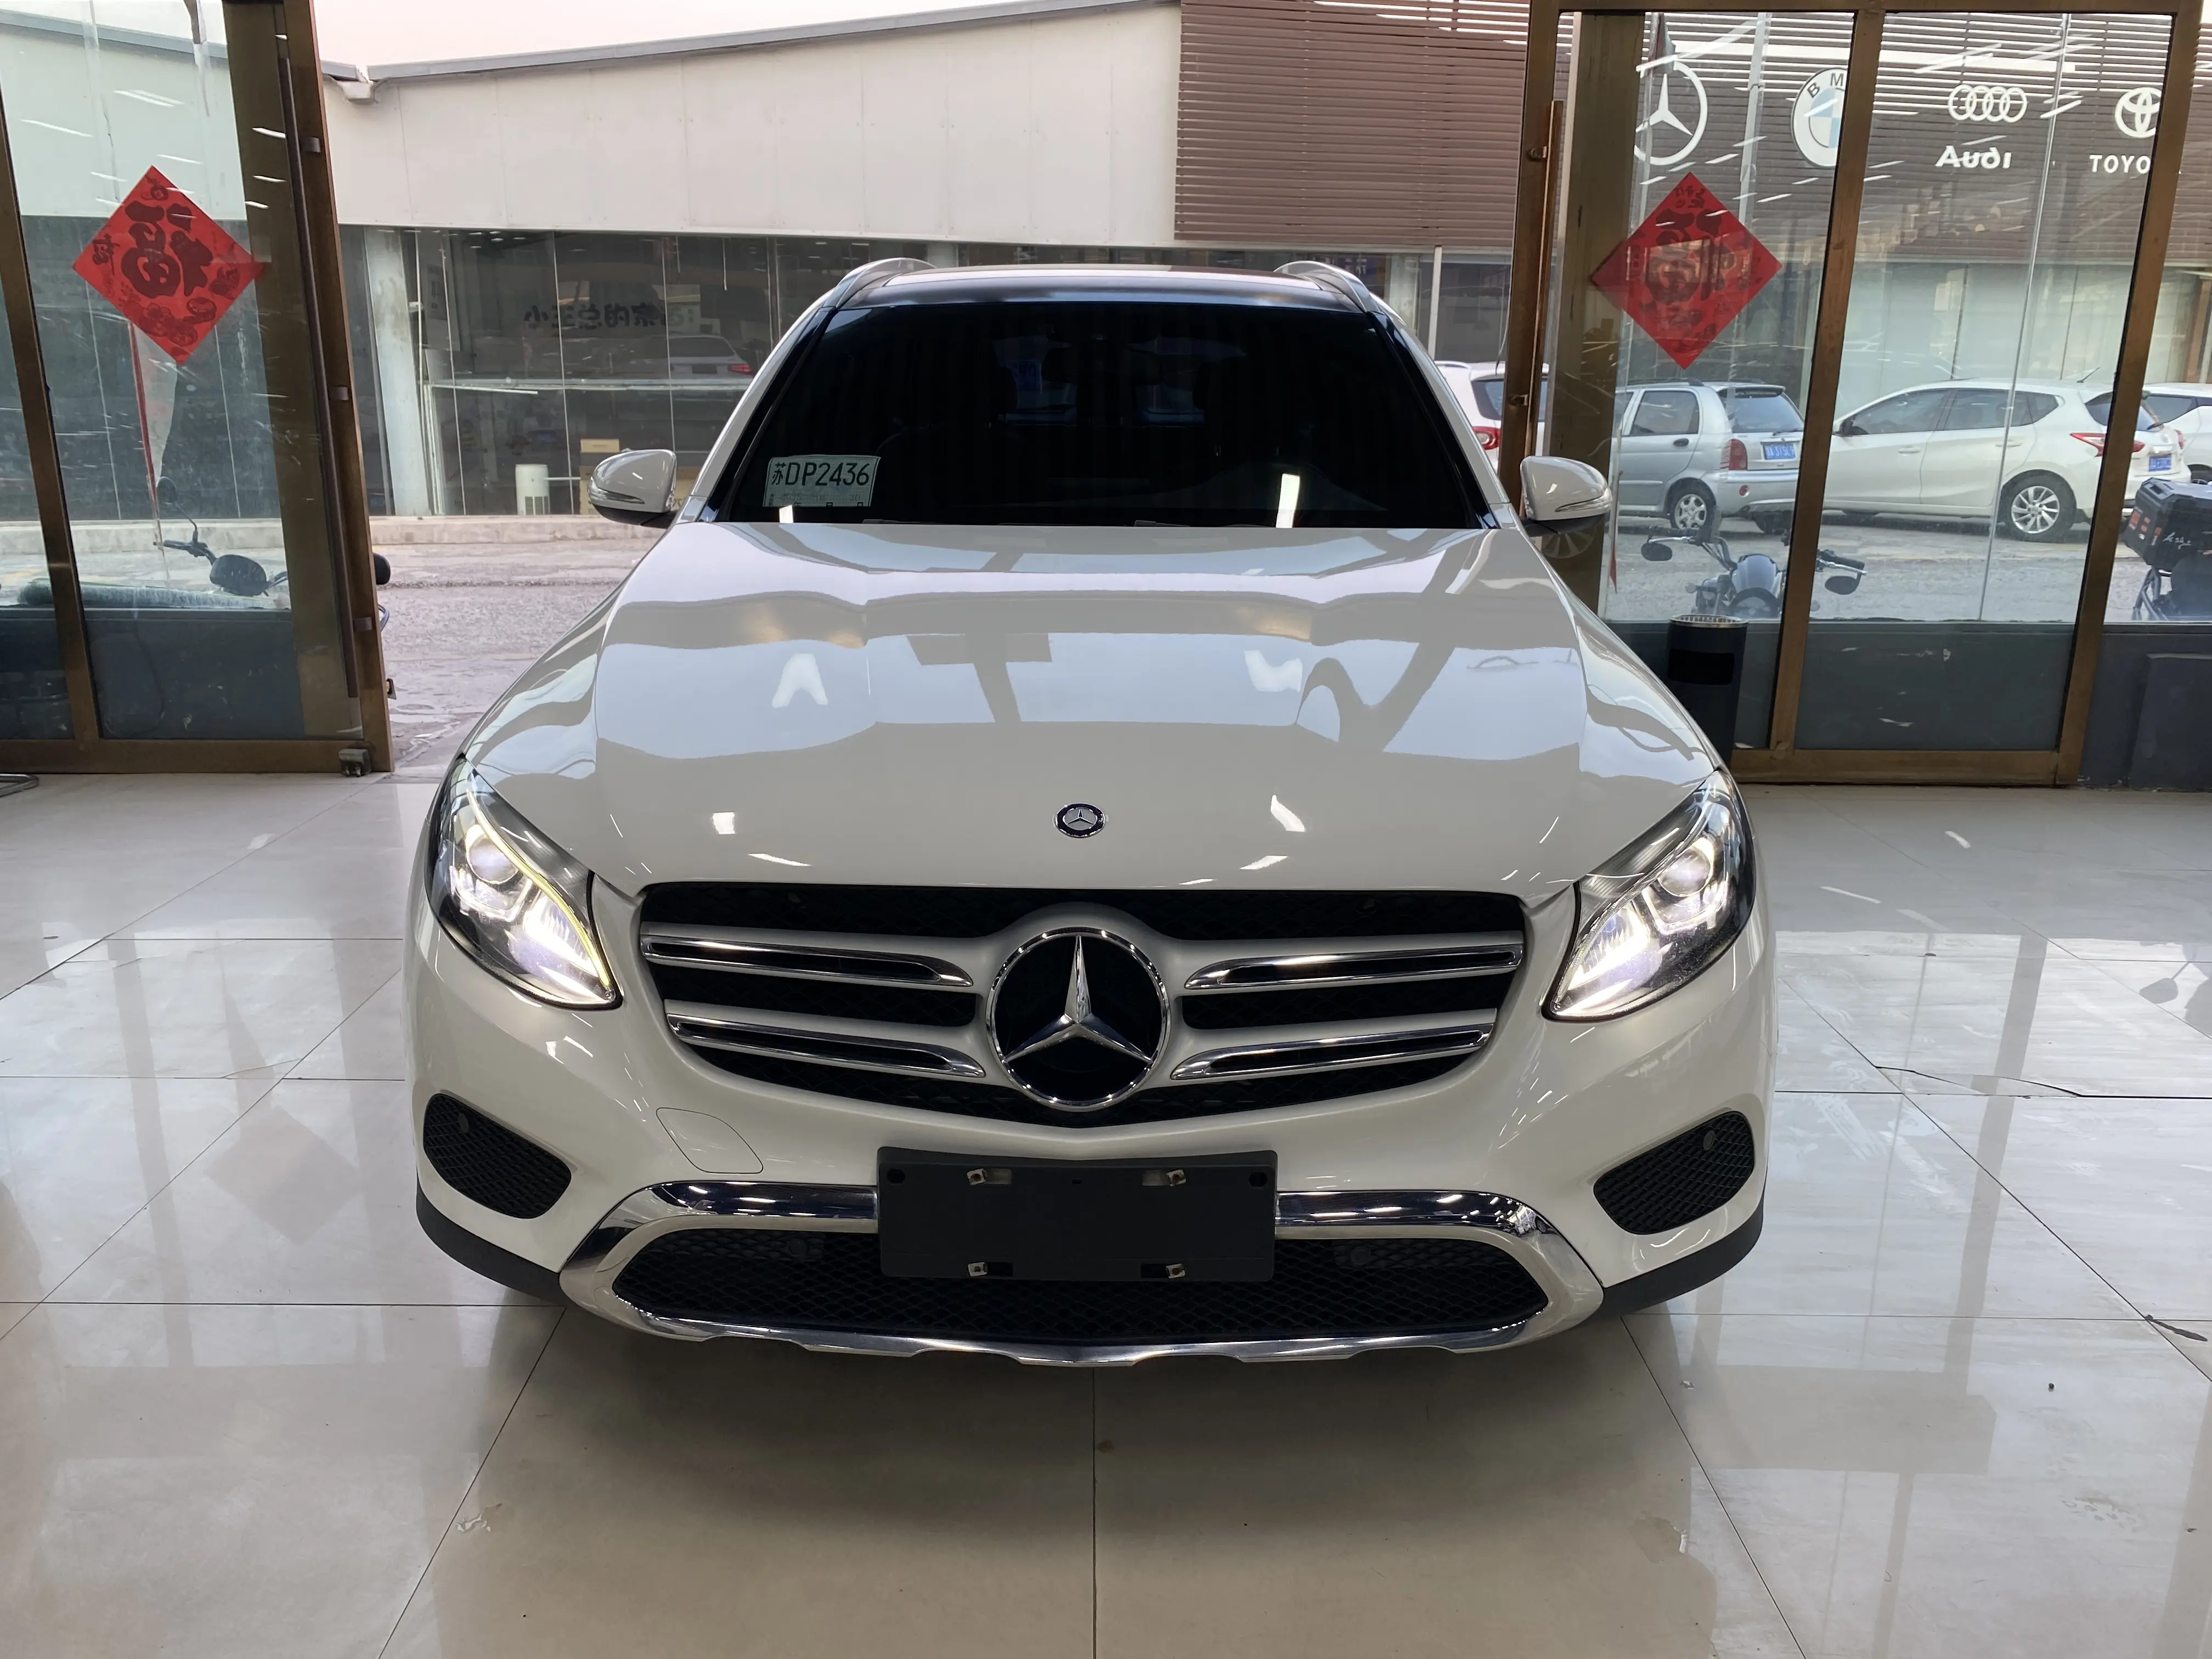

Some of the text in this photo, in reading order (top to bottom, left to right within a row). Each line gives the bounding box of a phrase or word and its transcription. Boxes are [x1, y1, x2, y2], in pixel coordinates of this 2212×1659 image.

[1935, 145, 2012, 169] Audi
[2089, 154, 2151, 174] TOYO
[771, 462, 870, 486] 苏DP2436
